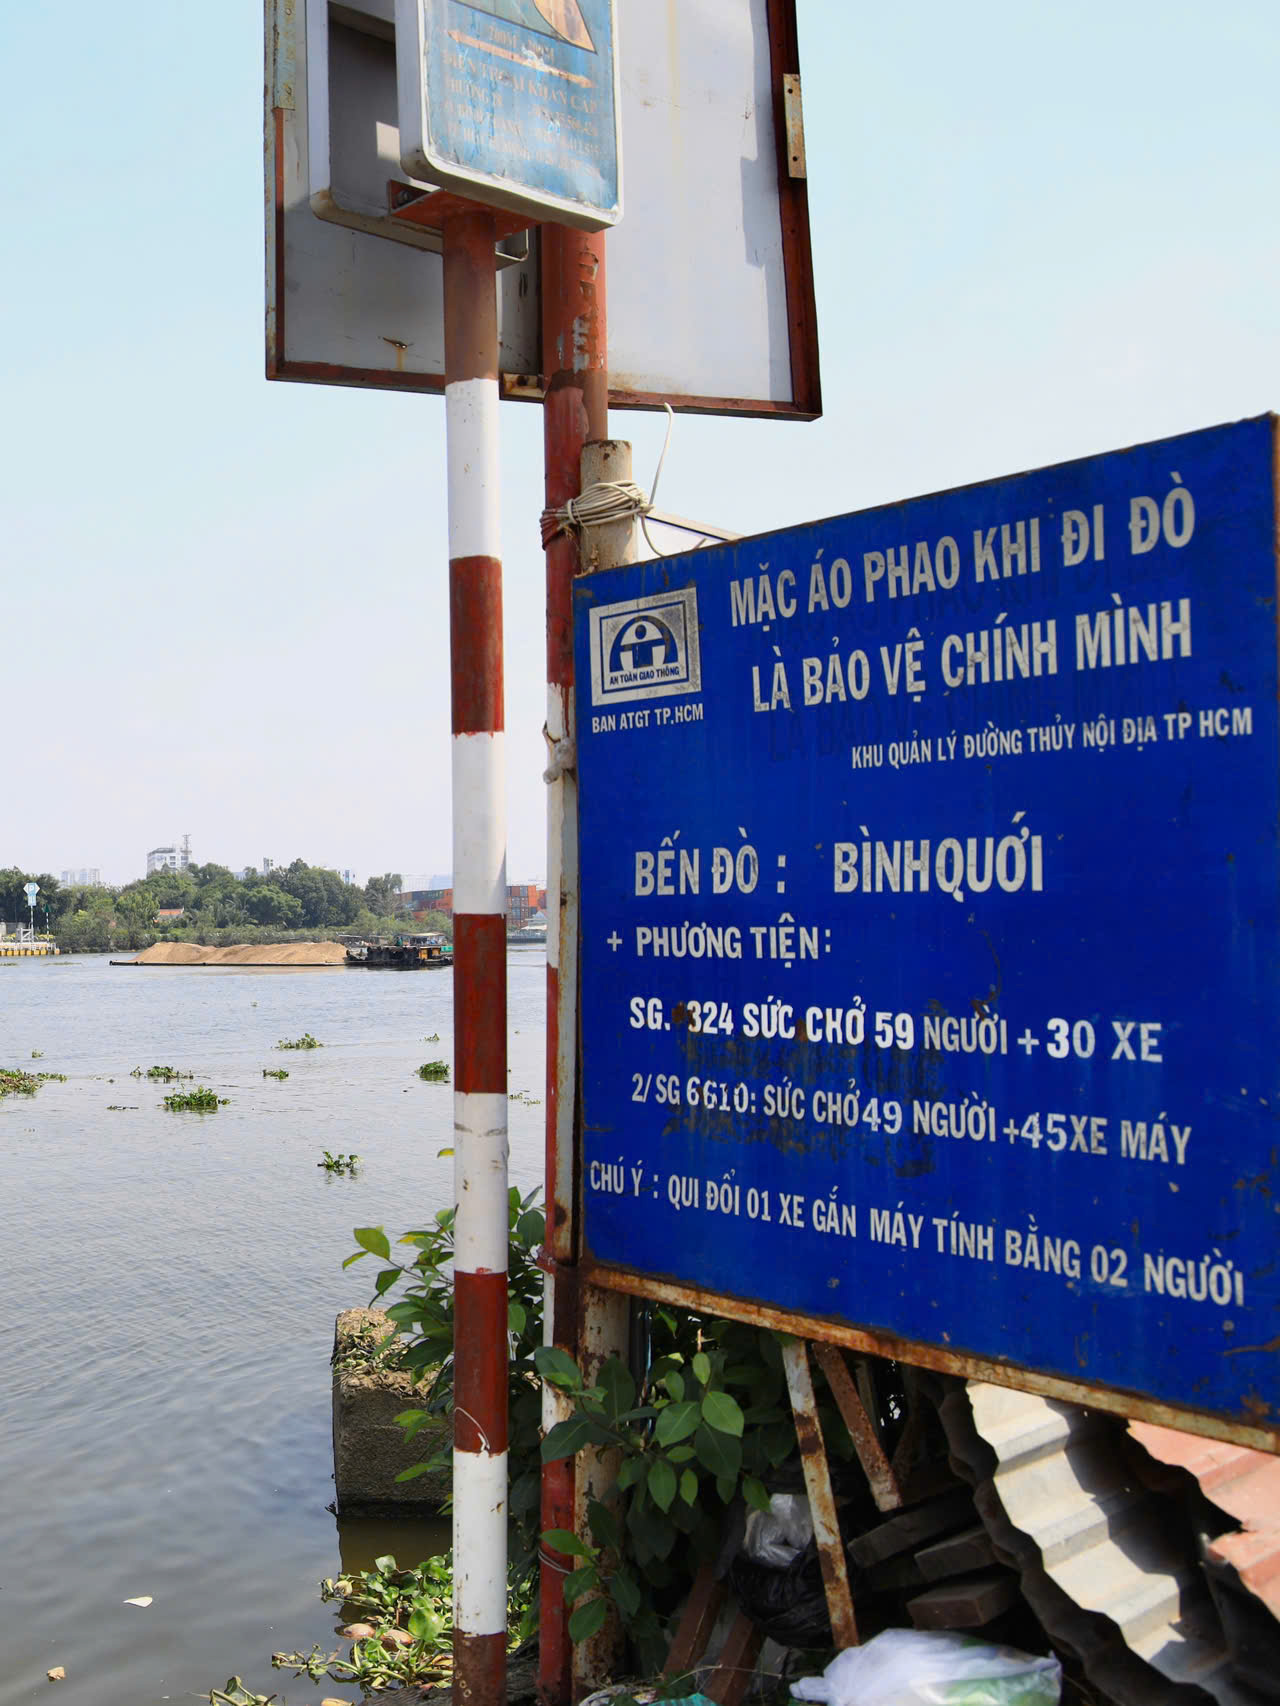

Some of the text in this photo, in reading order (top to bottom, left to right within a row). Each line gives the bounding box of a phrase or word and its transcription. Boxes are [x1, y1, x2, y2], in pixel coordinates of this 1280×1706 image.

[730, 471, 1195, 632] MẶC ÁO PHAO KHI ĐI ĐÒ
[610, 666, 680, 686] AN TOÀN GIAO THÔNG
[752, 592, 1192, 713] LÀ BẢO VỆ CHÍNH MÌNH
[591, 703, 704, 733] BAN ATGT TP.HCM
[852, 707, 1253, 769] KHU QUẢN LÝ ĐƯỜNG THỦY NỘI ĐỊA TP HCM
[635, 830, 700, 896] BẾN
[711, 826, 759, 894] ĐÒ
[636, 920, 742, 959] PHƯƠNG
[742, 995, 796, 1040] SỨC
[805, 995, 867, 1046] CHỞ
[874, 1011, 915, 1051] 59
[923, 1004, 1008, 1055] NGƯỜI
[1111, 1021, 1163, 1063] XE
[763, 1076, 805, 1120] SỨC
[913, 1091, 996, 1142] NGƯỜI
[1121, 1111, 1192, 1165] MÁY
[590, 1156, 624, 1194] CHÚ
[631, 1159, 643, 1197] Ý
[668, 1174, 699, 1211] QUI
[705, 1168, 740, 1216] ĐỔI
[746, 1187, 771, 1222] 01
[779, 1192, 805, 1228] XE
[812, 1185, 857, 1238] GẮN
[870, 1201, 924, 1249] MÁY
[932, 1211, 994, 1262] TÍNH
[1005, 1214, 1081, 1279] BẰNG
[1091, 1245, 1128, 1288] 02
[1143, 1248, 1244, 1305] NGƯỜI
